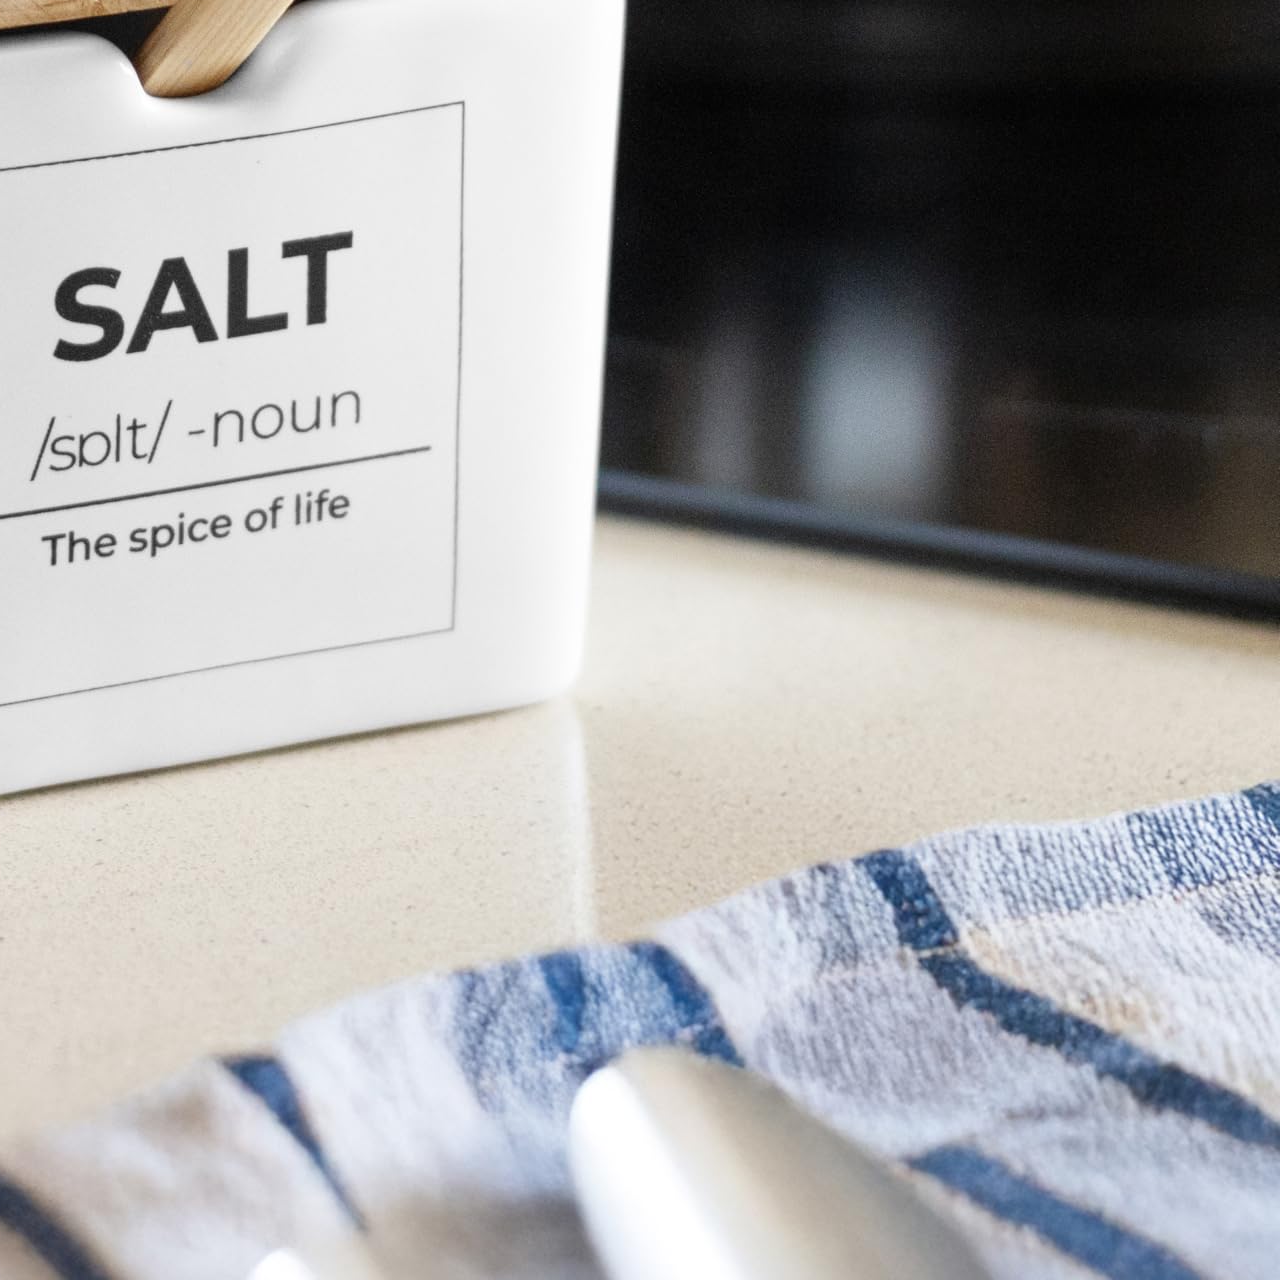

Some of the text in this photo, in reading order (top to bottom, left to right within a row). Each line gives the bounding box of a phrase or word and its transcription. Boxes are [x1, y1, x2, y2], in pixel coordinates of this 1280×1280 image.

[52, 230, 354, 363] SALT
[187, 390, 361, 448] -noun
[40, 488, 351, 567] The spice of life
